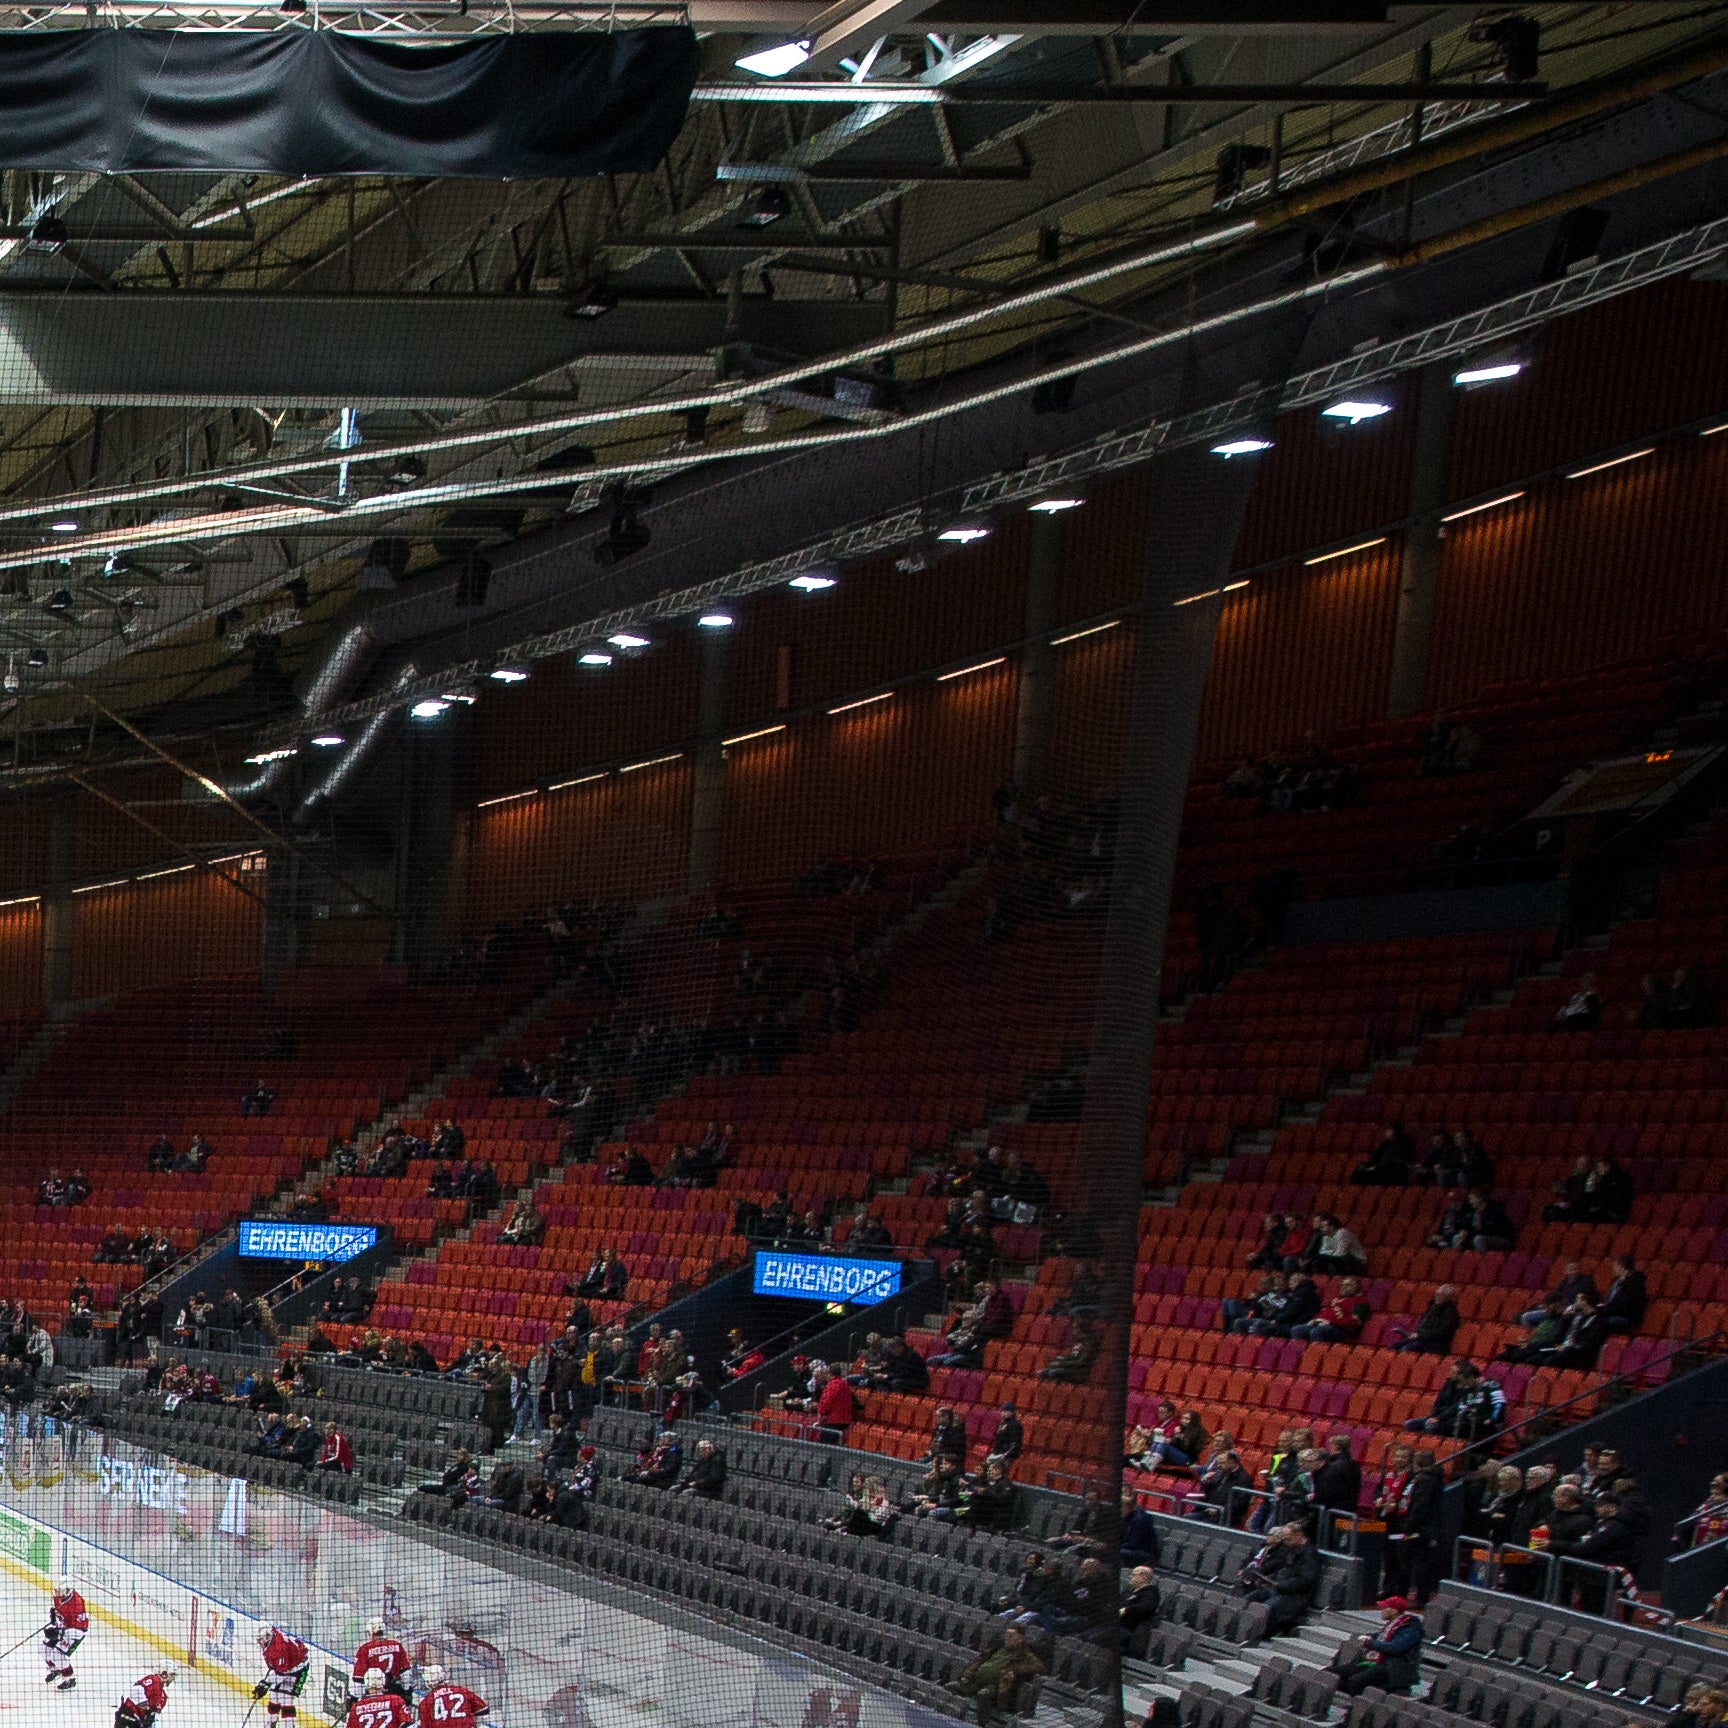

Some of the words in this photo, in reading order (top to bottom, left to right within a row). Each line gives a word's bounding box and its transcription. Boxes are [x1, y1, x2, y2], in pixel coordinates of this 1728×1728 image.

[248, 1228, 369, 1256] EHRENBORG
[761, 1260, 892, 1297] EHRENBORG
[433, 1693, 467, 1721] 42
